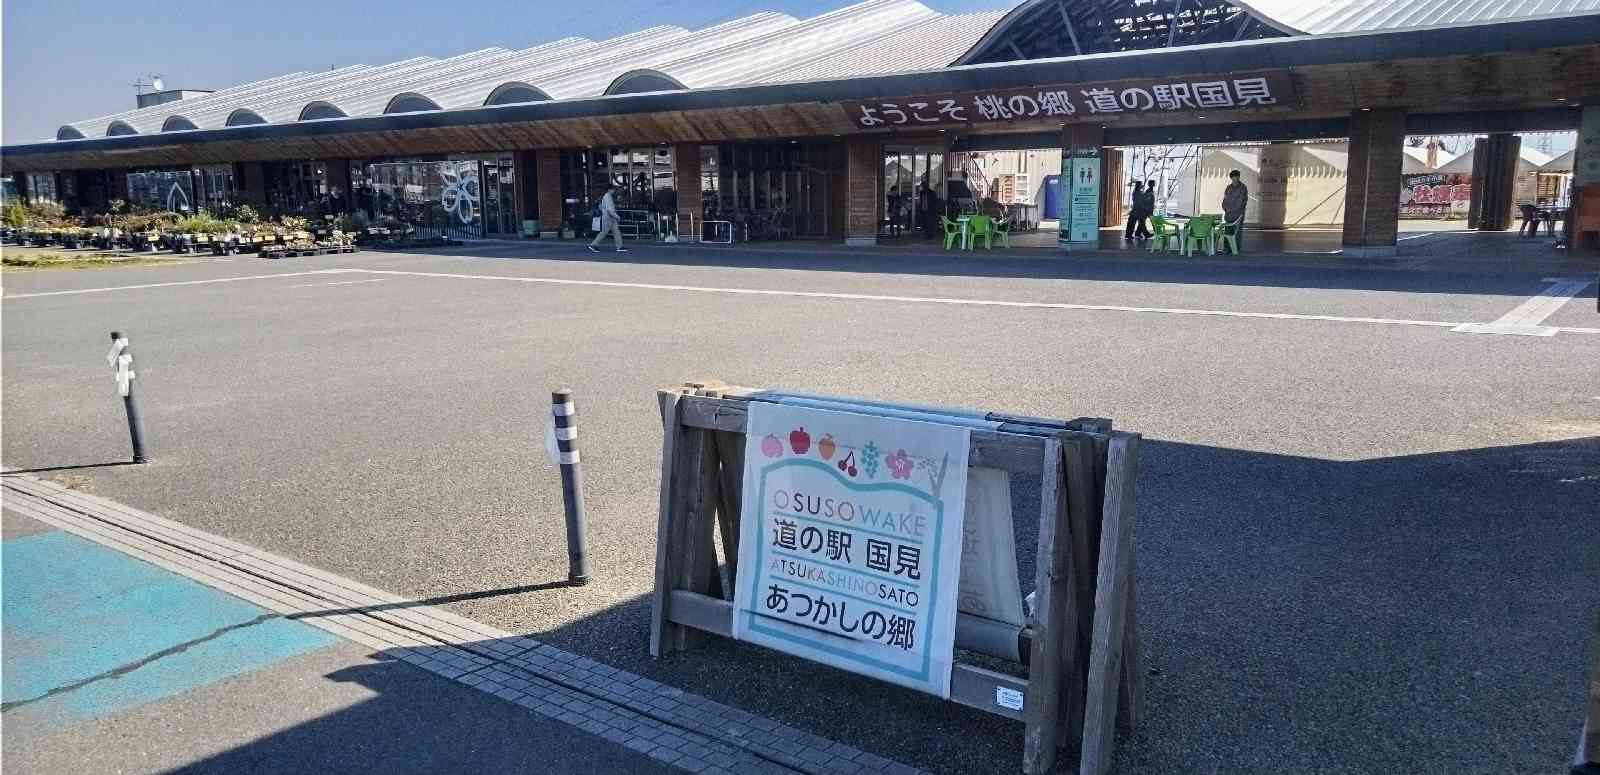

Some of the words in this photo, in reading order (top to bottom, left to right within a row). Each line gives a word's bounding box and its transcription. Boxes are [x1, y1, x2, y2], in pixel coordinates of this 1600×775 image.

[860, 100, 968, 126] ようこそ
[974, 91, 1076, 119] 桃の郷
[1081, 77, 1276, 113] 道の駅国見
[774, 489, 926, 537] OSUSOWAKE
[772, 518, 852, 564] 道の駅
[865, 538, 921, 580] 国見
[771, 559, 919, 607] ATSUKASHINOSATO
[766, 584, 916, 651] あつかしの郷
